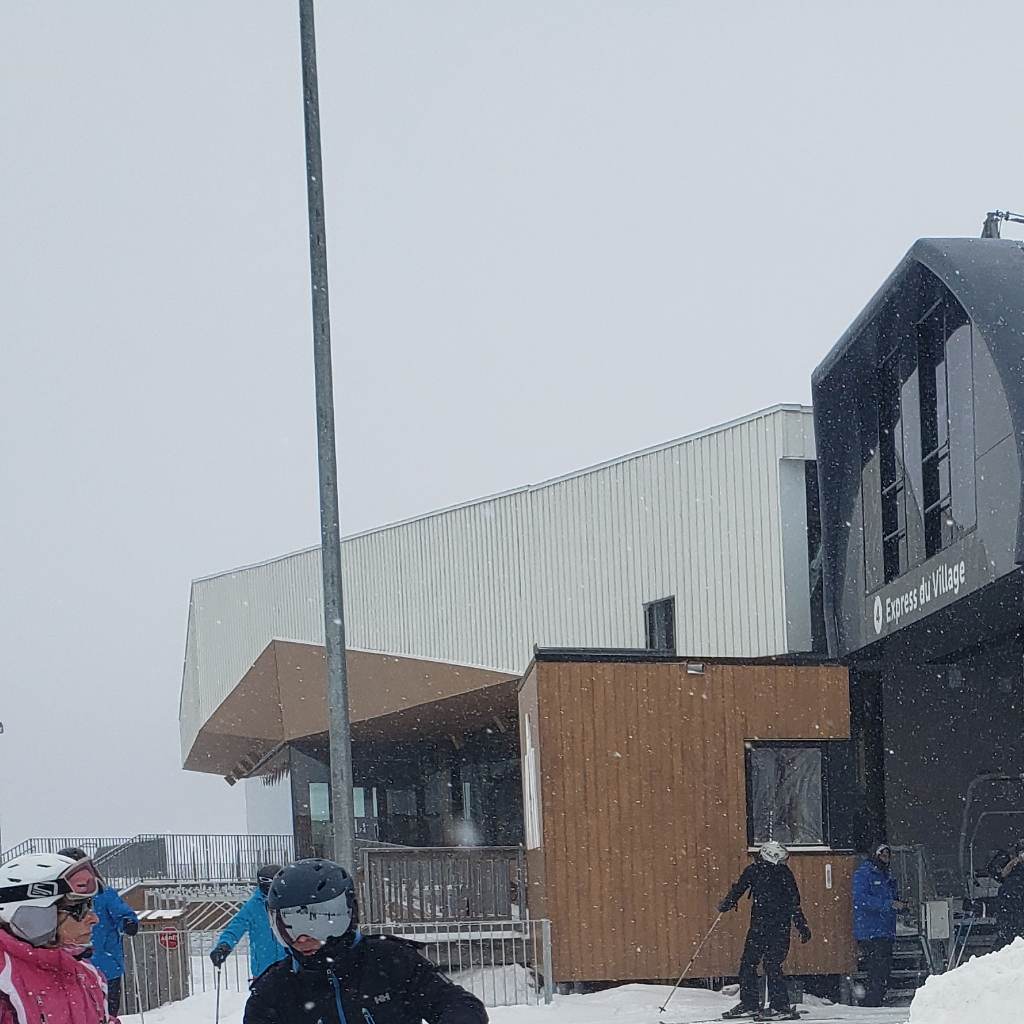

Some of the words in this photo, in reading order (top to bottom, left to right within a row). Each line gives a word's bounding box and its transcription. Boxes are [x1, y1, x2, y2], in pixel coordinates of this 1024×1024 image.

[885, 588, 918, 625] Express
[919, 577, 931, 605] du
[932, 560, 965, 598] Village
